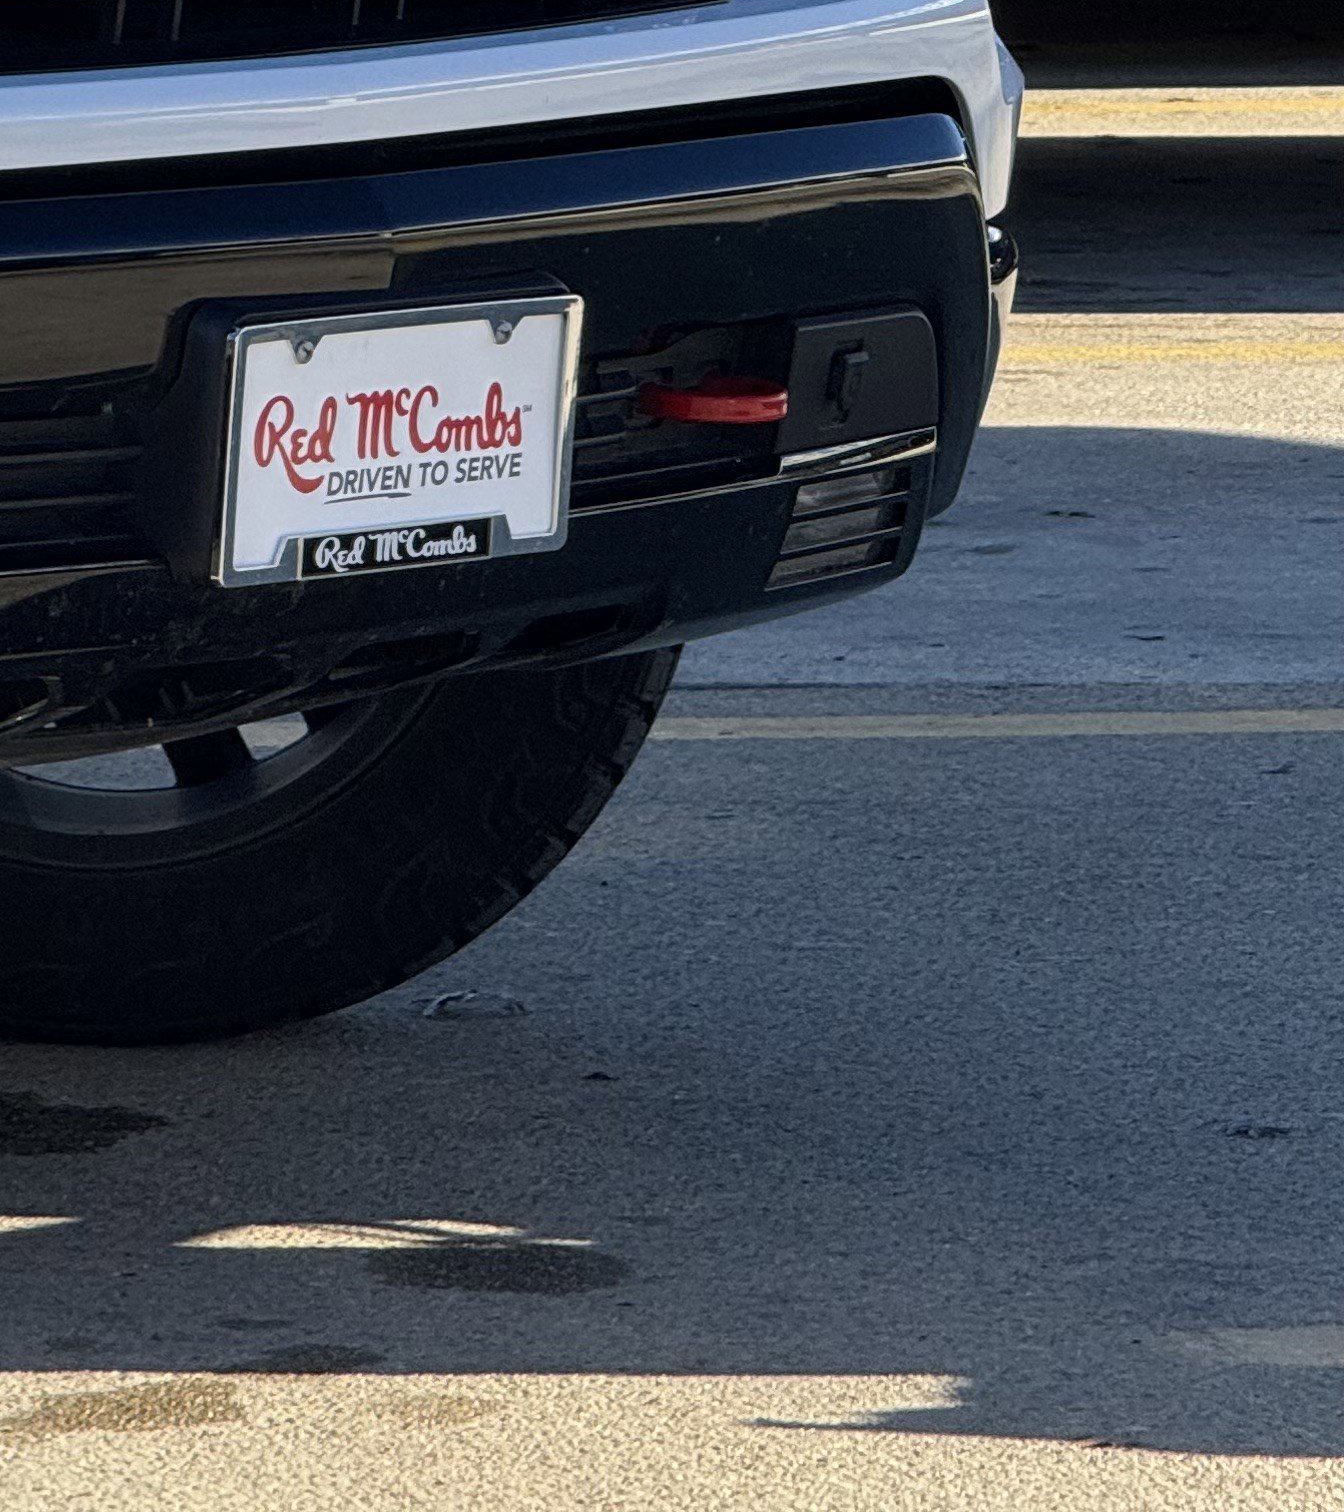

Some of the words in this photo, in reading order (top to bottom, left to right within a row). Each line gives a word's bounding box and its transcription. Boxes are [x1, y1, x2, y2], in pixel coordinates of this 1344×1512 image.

[253, 395, 338, 495] Red
[346, 382, 522, 460] McCombs
[326, 464, 412, 497] DRIVEN
[419, 460, 450, 489] TO
[454, 453, 523, 483] SERVE
[314, 536, 364, 573] Red
[369, 524, 478, 561] McCombs
